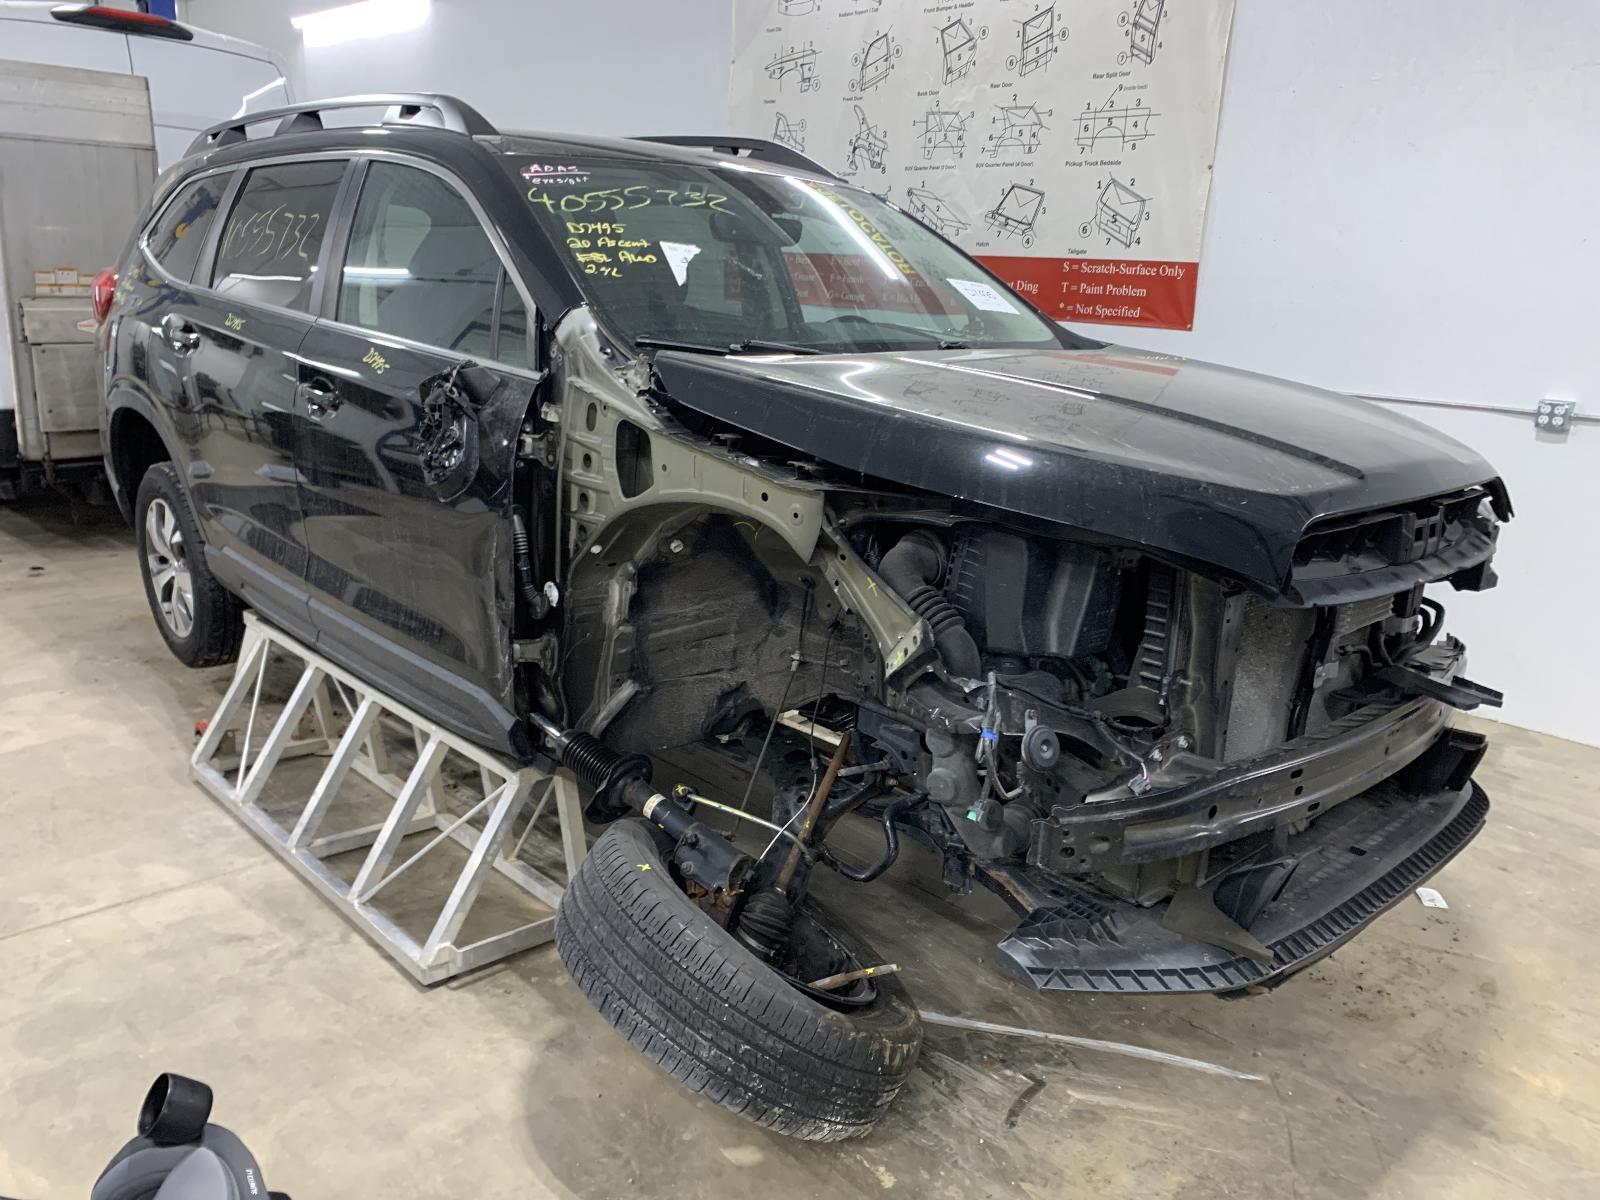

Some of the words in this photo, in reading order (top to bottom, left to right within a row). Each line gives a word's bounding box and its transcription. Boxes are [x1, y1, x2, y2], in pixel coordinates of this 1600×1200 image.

[1108, 118, 1112, 126] 5
[1084, 124, 1089, 132] 6
[530, 163, 578, 173] ADAS
[1097, 181, 1101, 189] 1
[1145, 212, 1149, 220] 3
[1082, 226, 1087, 234] 6
[1135, 237, 1140, 245] 4
[1063, 261, 1069, 272] S
[1081, 262, 1156, 276] Scratch-Surface
[1160, 265, 1185, 279] Only
[1017, 280, 1039, 294] Ding
[1062, 282, 1069, 292] T
[1080, 283, 1103, 295] Paint
[1106, 284, 1146, 296] Problem
[1076, 304, 1092, 314] Not
[1095, 304, 1140, 318] Specified
